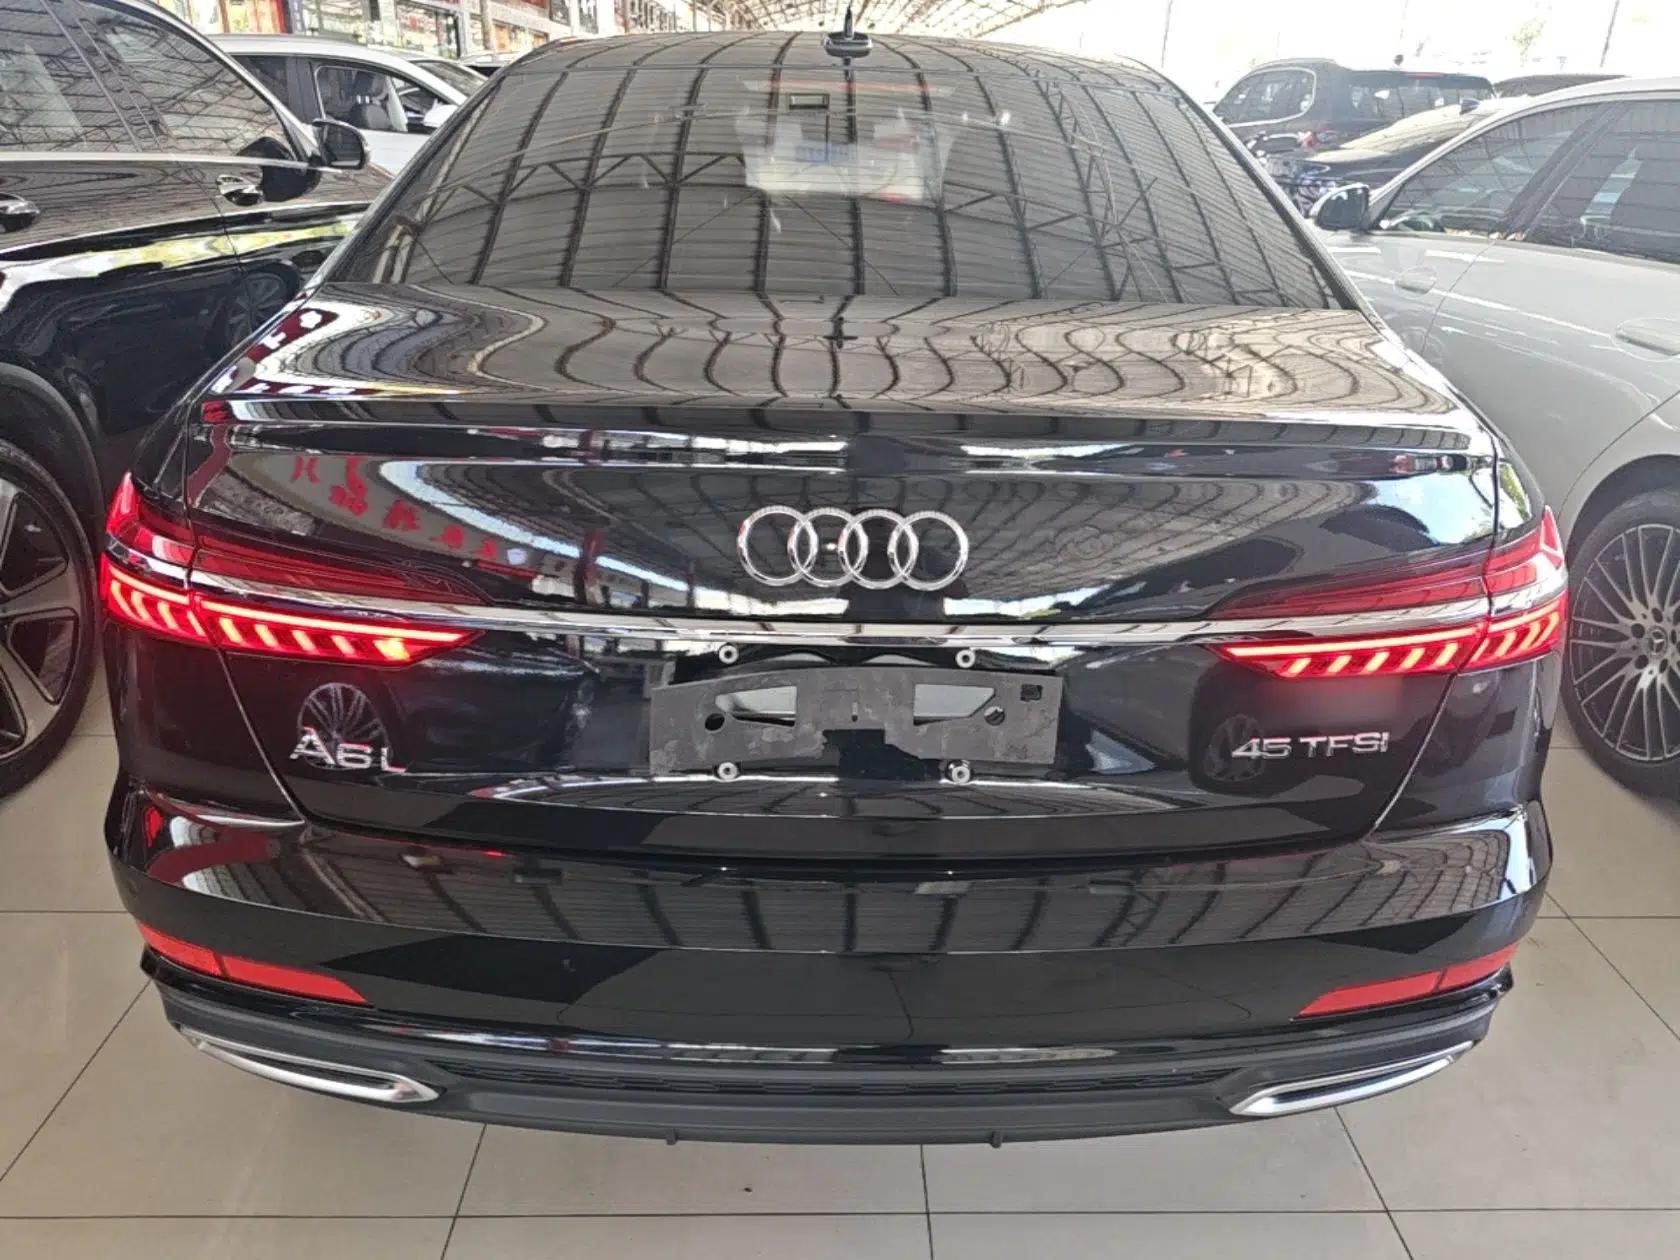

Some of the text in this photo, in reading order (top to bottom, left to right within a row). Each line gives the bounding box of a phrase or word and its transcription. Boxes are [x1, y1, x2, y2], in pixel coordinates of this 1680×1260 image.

[289, 726, 407, 774] A6L
[1231, 731, 1390, 759] 45 TFSI
